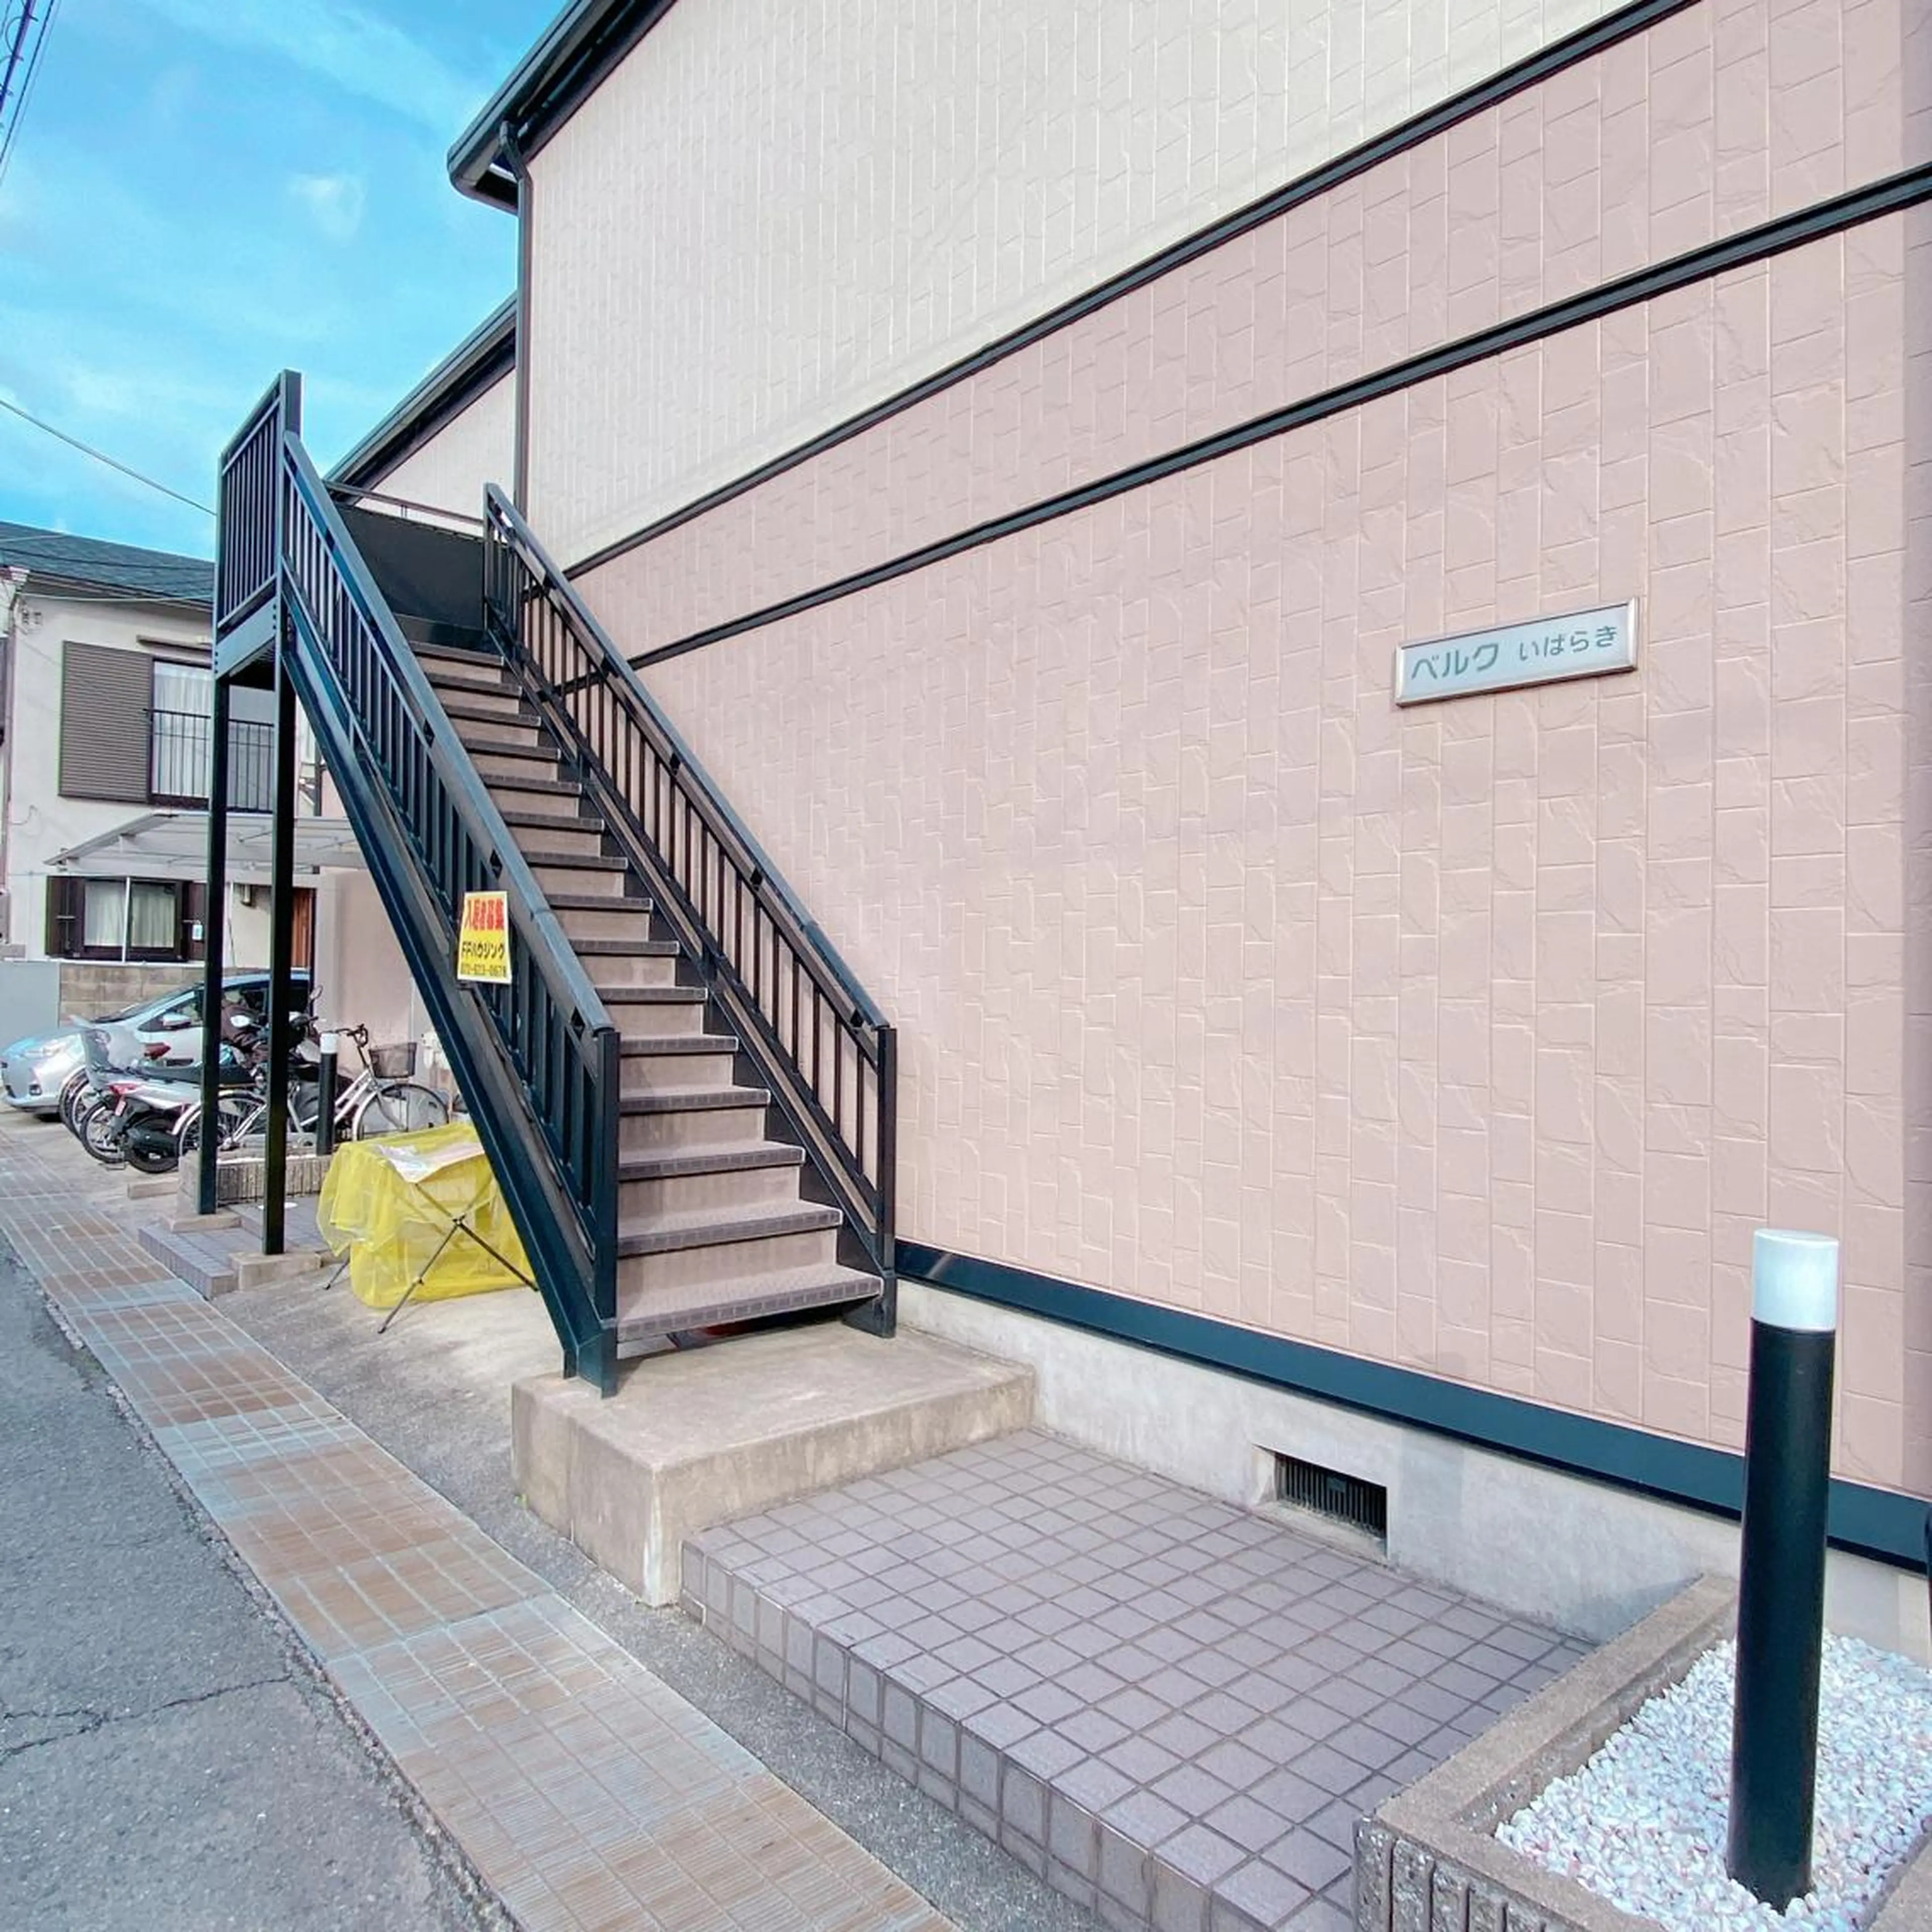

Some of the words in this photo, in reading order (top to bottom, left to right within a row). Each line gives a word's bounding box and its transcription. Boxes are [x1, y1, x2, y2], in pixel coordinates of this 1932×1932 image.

[1411, 643, 1499, 679] ベルク
[1519, 626, 1617, 661] いはらき
